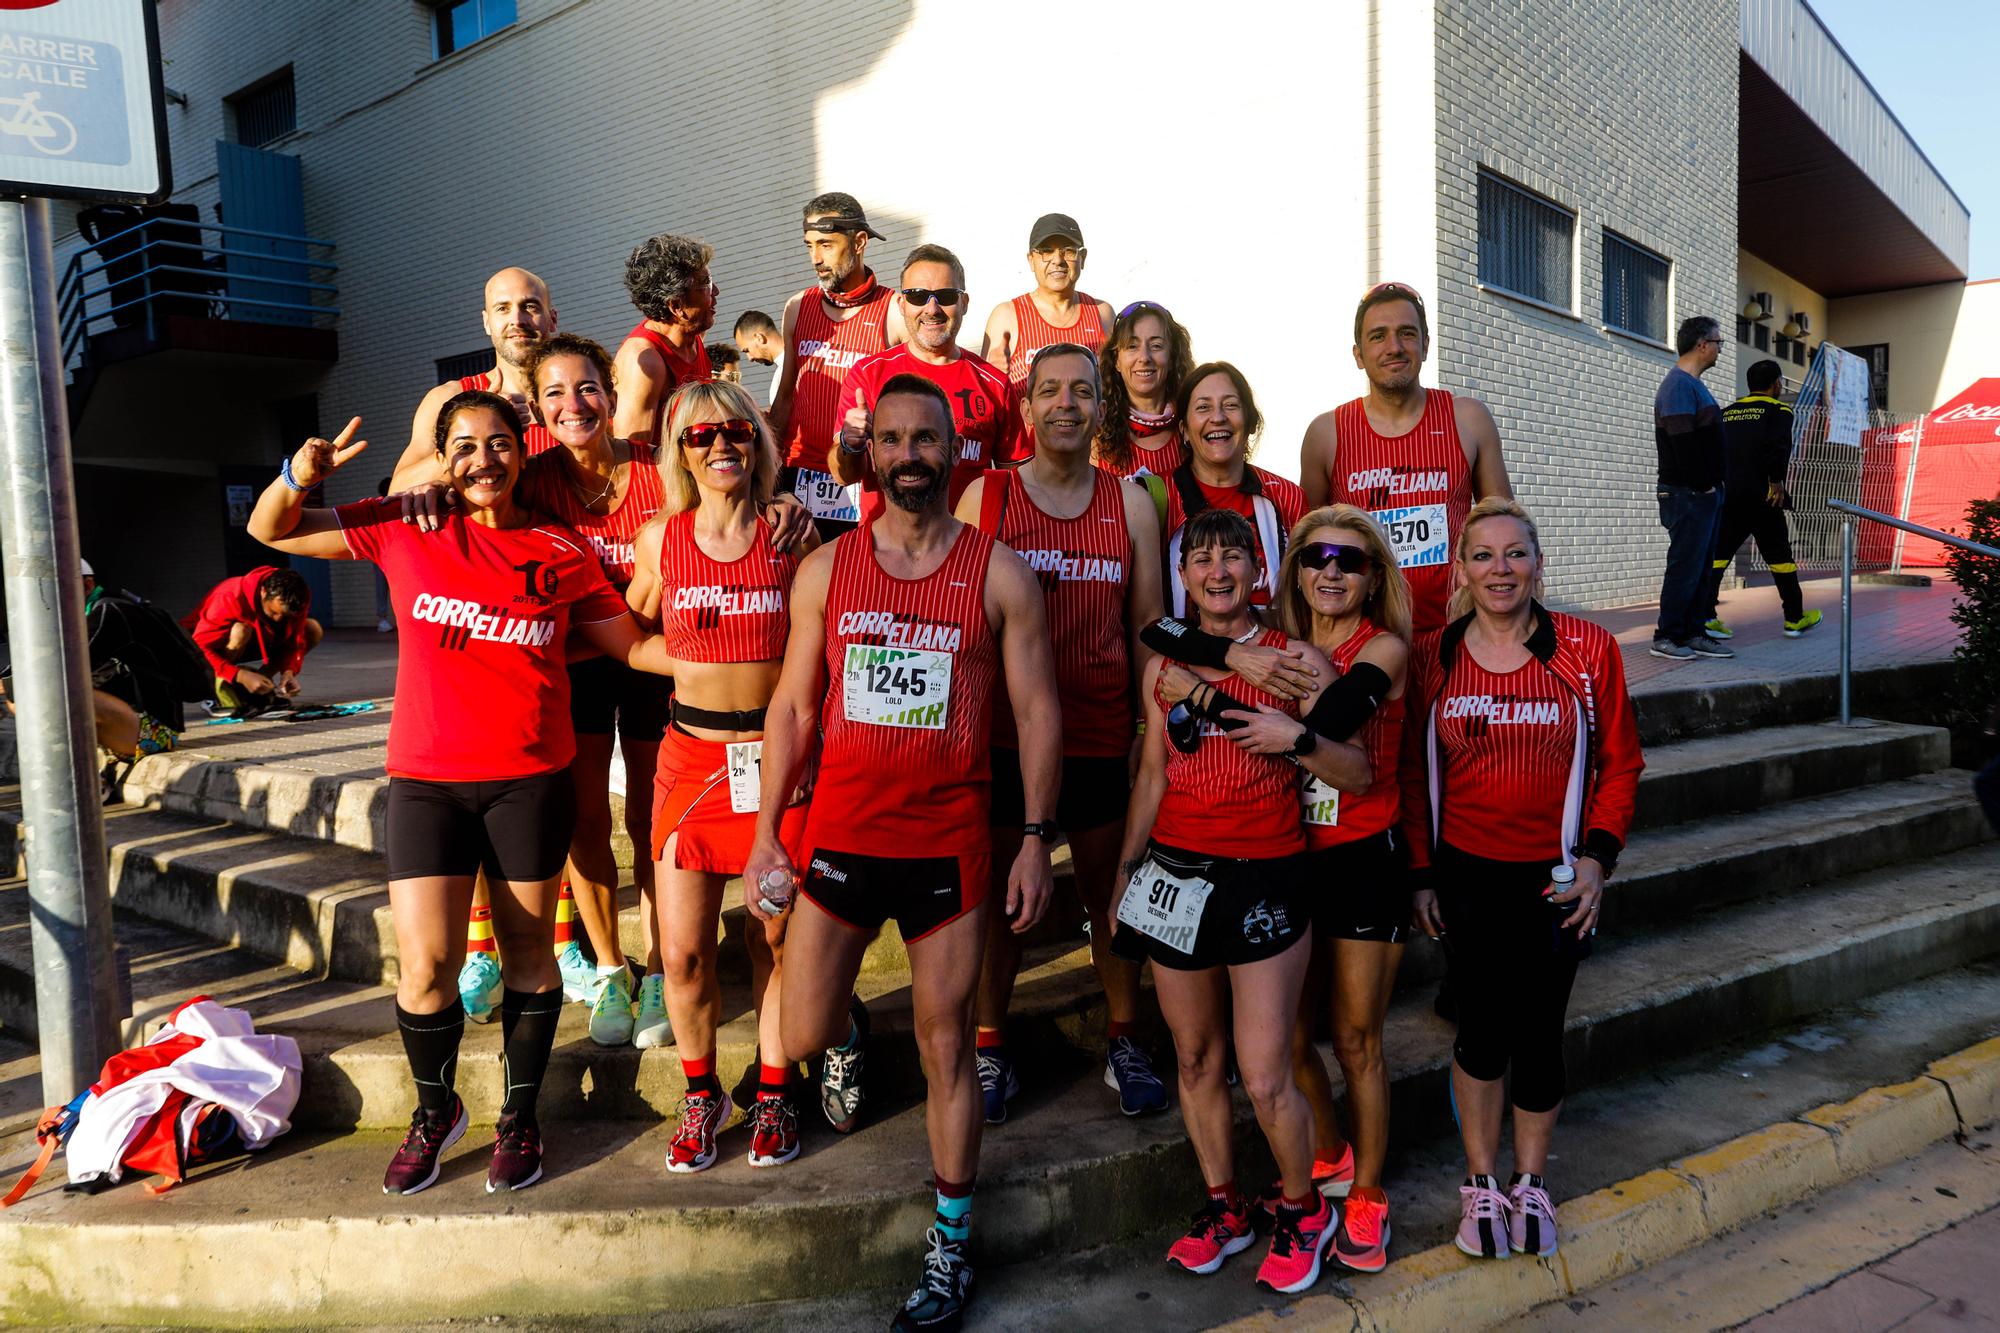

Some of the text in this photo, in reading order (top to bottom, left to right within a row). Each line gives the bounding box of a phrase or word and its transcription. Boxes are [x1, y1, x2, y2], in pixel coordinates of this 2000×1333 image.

[816, 482, 843, 500] 917
[1347, 467, 1448, 495] CORRELIANA
[674, 585, 783, 616] CORRELIANA
[412, 592, 555, 647] CORRELIANA
[838, 611, 961, 653] CORRELIANA
[866, 664, 927, 697] 1245
[885, 697, 902, 705] LOLO
[1443, 695, 1559, 726] CORRELIANA
[812, 859, 848, 883] CORRELIANA
[1149, 878, 1180, 913] 911
[1147, 906, 1168, 921] DESIREE
